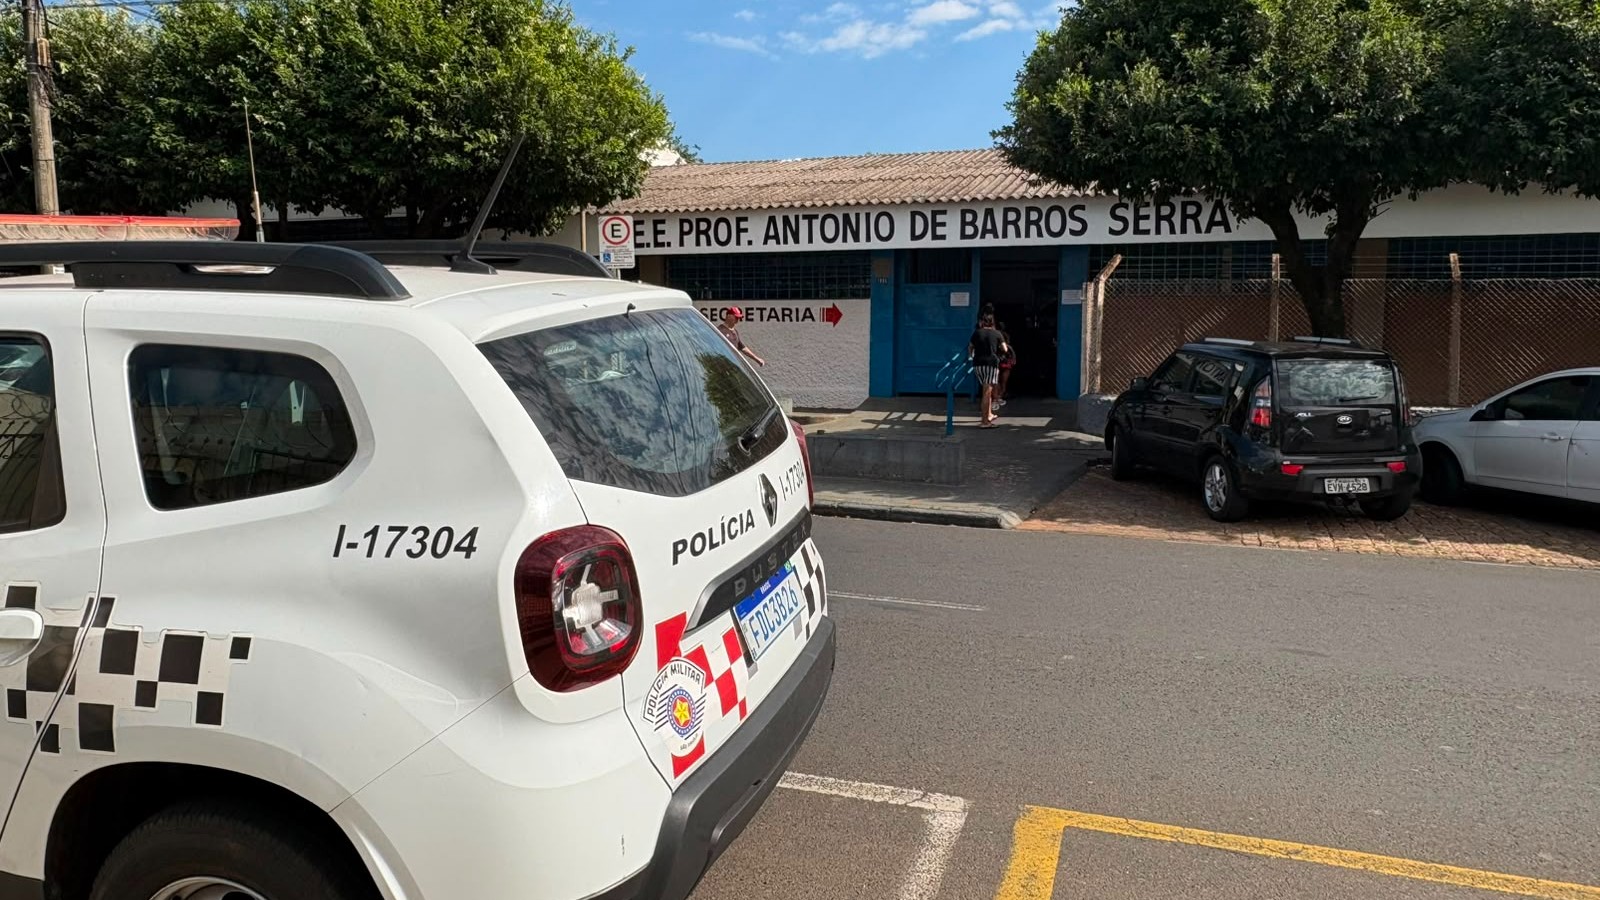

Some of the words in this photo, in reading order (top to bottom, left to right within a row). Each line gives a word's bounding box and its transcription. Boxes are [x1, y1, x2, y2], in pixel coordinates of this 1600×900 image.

[611, 223, 622, 238] E
[633, 219, 671, 248] E.E.
[679, 217, 753, 247] PROF.
[763, 211, 895, 245] ANTONIO
[910, 209, 947, 241] DE
[960, 204, 1088, 240] BARROS
[1108, 200, 1232, 236] SERRA
[700, 307, 815, 322] SECETARIA
[333, 524, 479, 559] I-17304
[672, 509, 755, 566] POLÍCIA
[734, 522, 807, 597] DUSTER
[749, 579, 798, 648] FDC3B26
[670, 663, 701, 685] MILITAR
